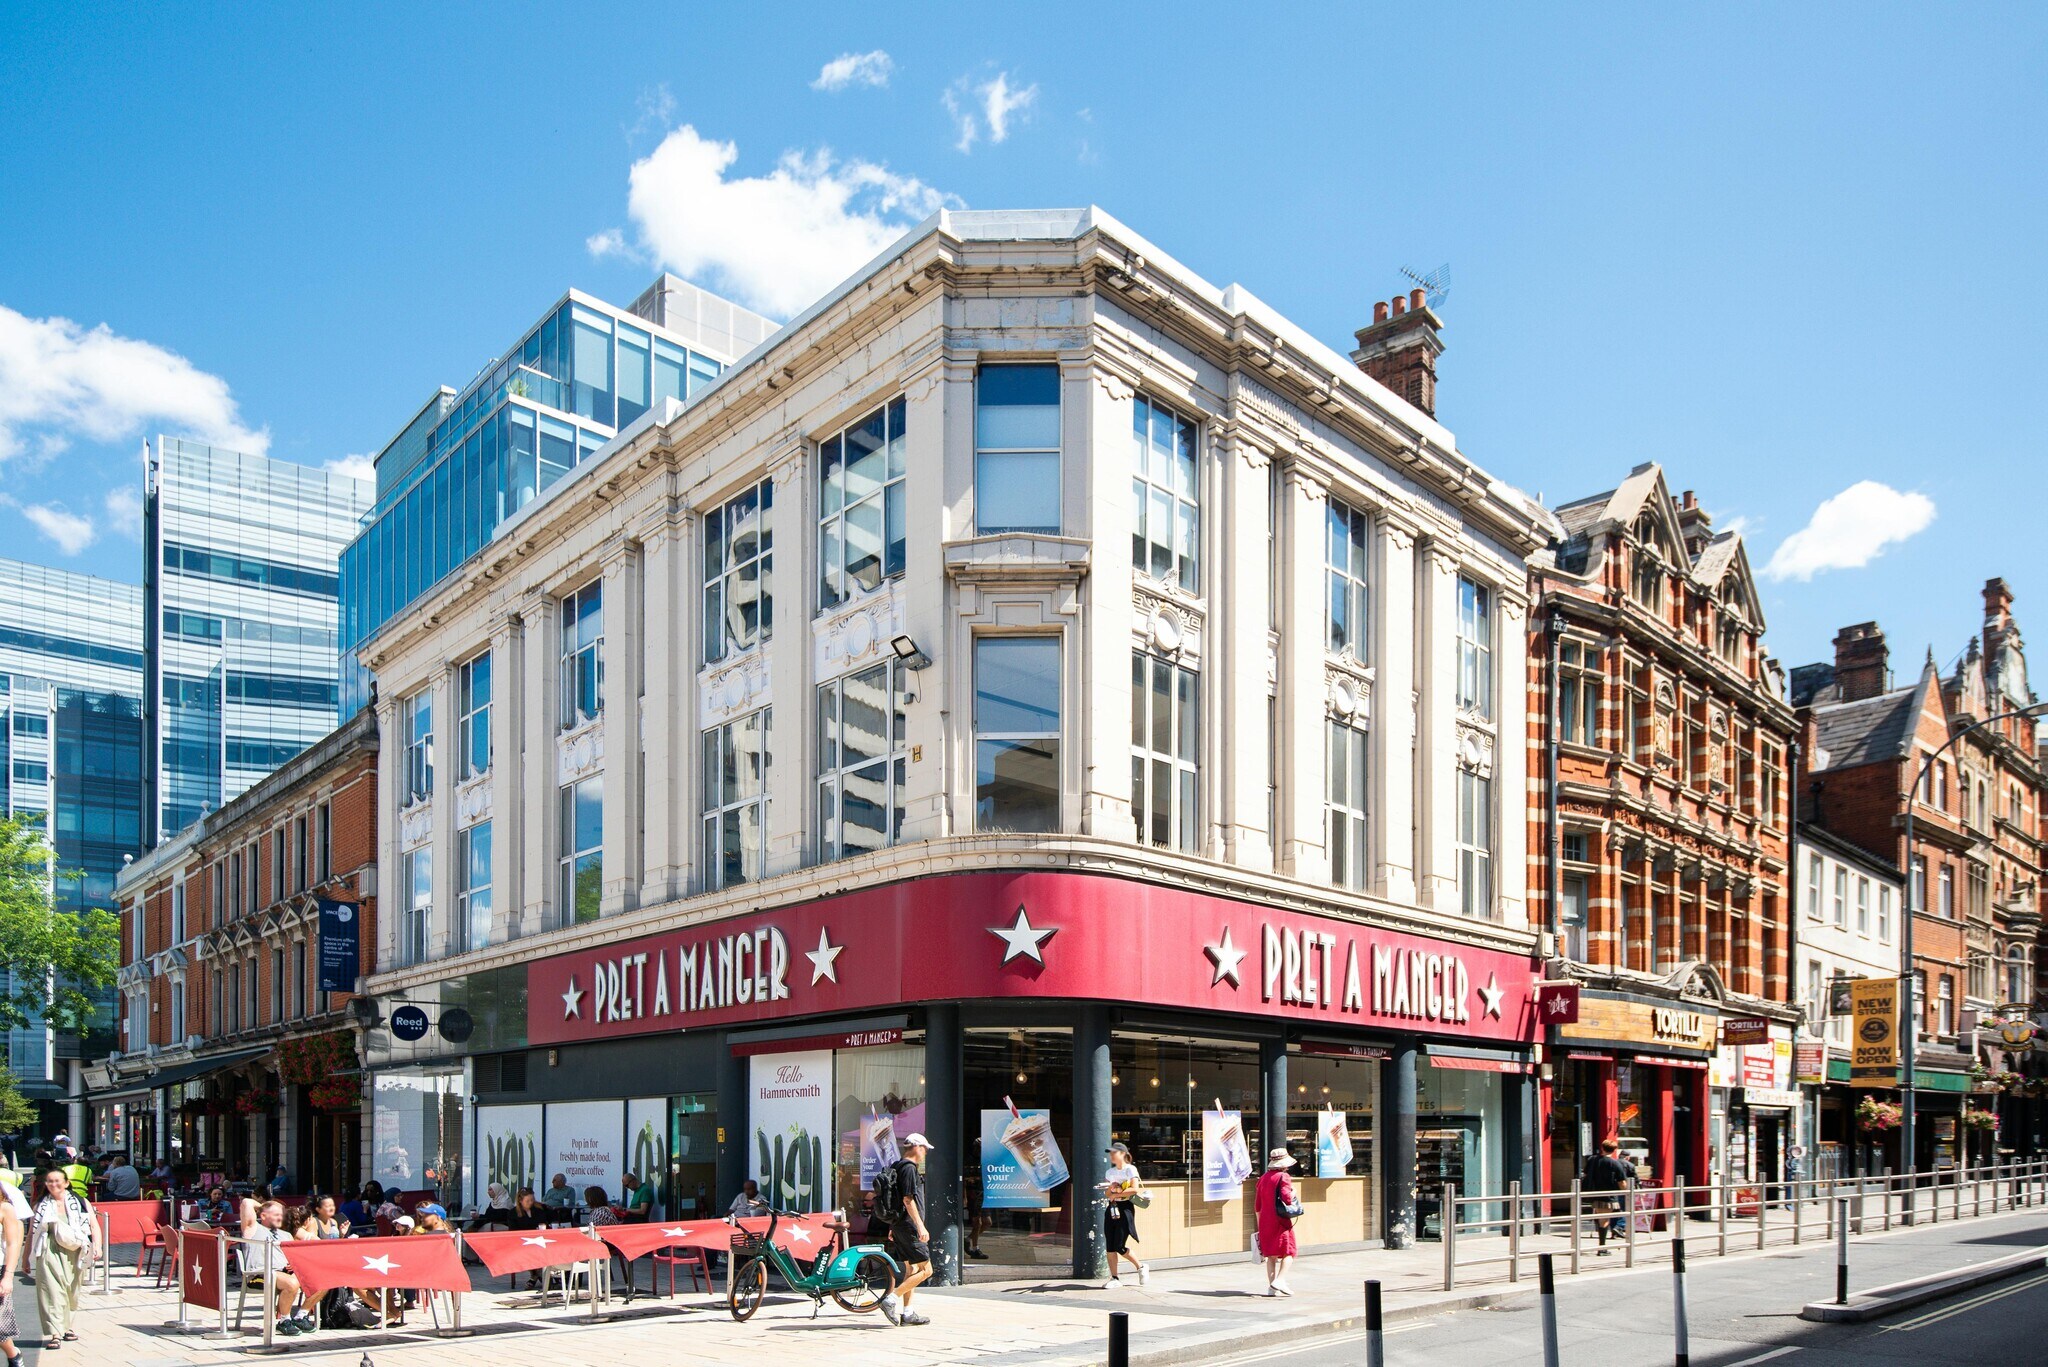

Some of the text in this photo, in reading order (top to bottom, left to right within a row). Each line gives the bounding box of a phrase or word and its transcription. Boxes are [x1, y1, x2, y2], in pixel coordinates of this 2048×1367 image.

[595, 926, 790, 1024] PRET A MANGER
[1262, 923, 1470, 1022] PRET A MANGER
[1858, 998, 1892, 1008] NEW
[1857, 1007, 1892, 1015] STORE
[396, 1016, 423, 1026] Reed
[1654, 1008, 1703, 1037] TORTILLA
[1726, 1021, 1765, 1030] TORTILLA
[850, 1031, 892, 1046] PRET A MANGER
[1857, 1047, 1891, 1056] NOW
[1857, 1055, 1891, 1064] OPEN
[775, 1065, 803, 1083] Hello
[760, 1084, 820, 1099] Hammersmith
[571, 1138, 599, 1150] Pop in for
[560, 1151, 611, 1164] freshly made food,
[1030, 1146, 1054, 1169] PRET
[566, 1165, 604, 1177] organic coffee
[987, 1164, 1015, 1173] Order
[987, 1174, 1009, 1183] your
[986, 1180, 1031, 1190] unusual
[816, 1253, 829, 1276] forest
